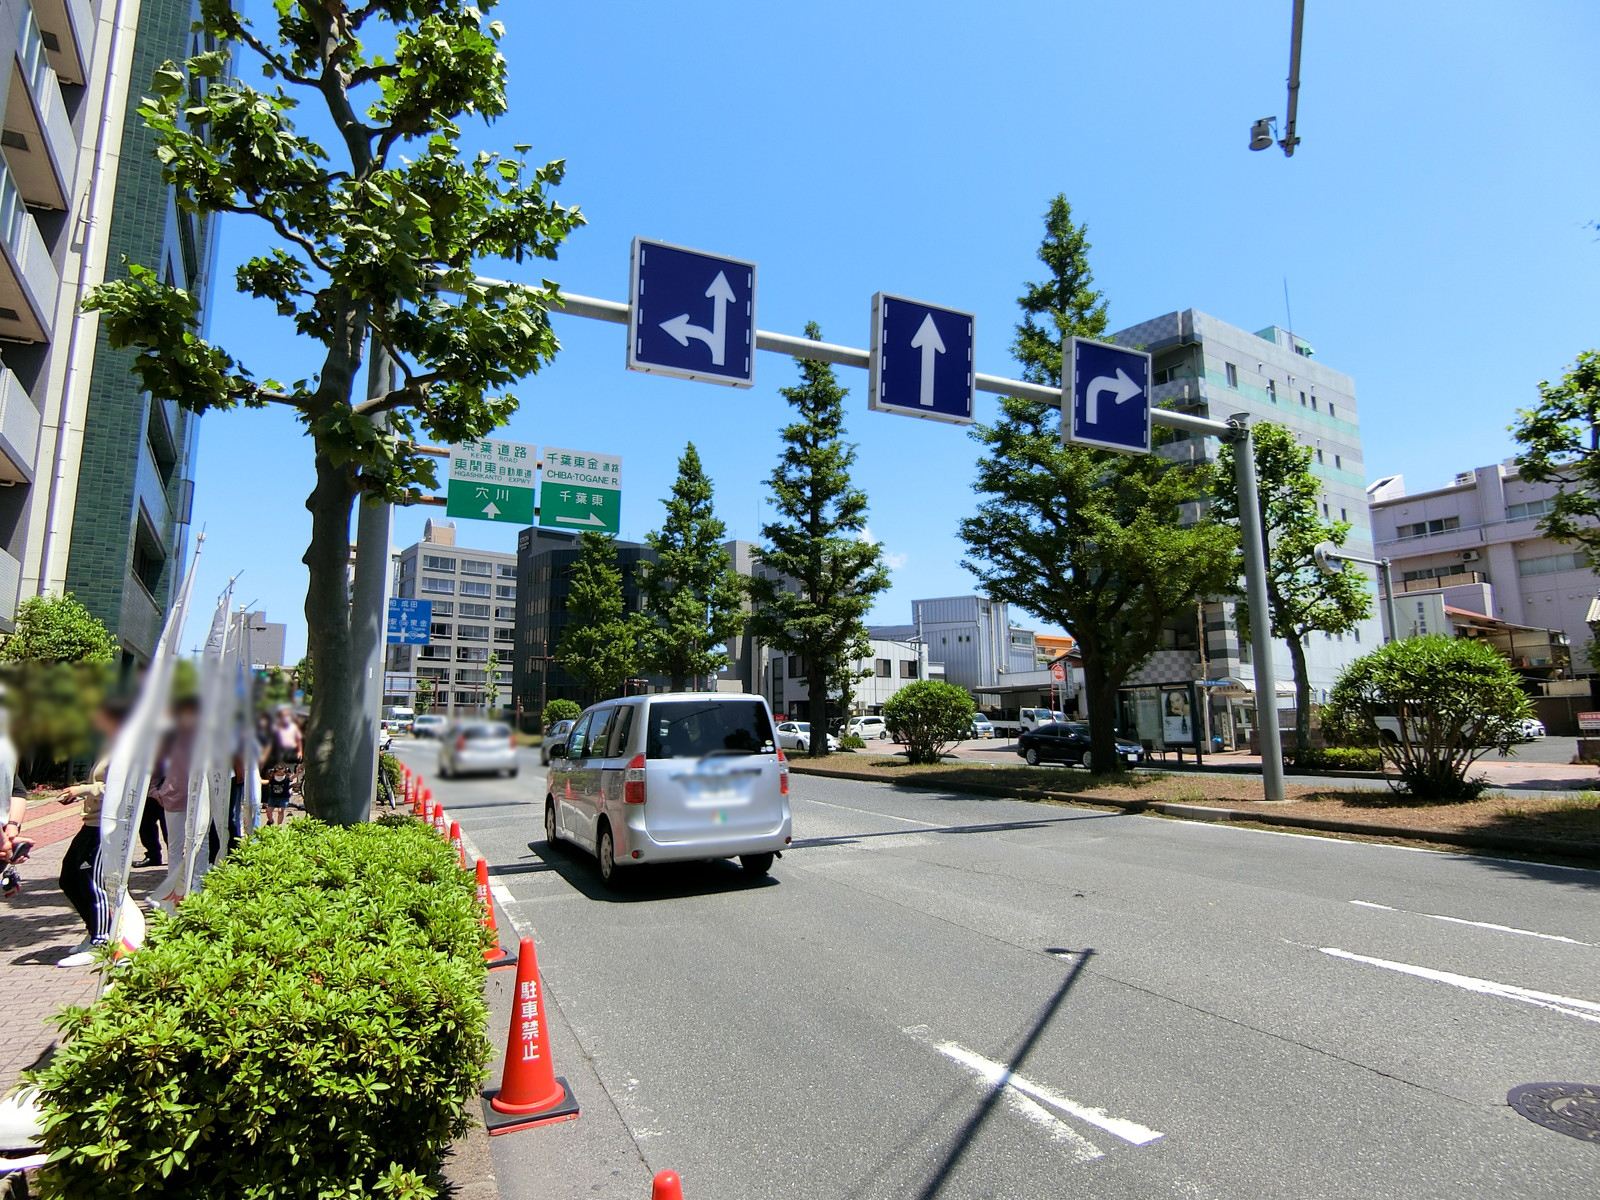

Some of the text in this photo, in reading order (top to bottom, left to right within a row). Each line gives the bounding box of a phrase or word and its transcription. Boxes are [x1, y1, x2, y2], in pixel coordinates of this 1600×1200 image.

[470, 452, 519, 464] KEIYO ROAD
[454, 470, 532, 485] HIGASHIKANTO EXPWY
[546, 469, 609, 485] CHIBA-TOGANE
[475, 487, 510, 502] 穴川
[559, 490, 604, 507] 千葉東
[520, 980, 540, 1061] 駐車禁止
